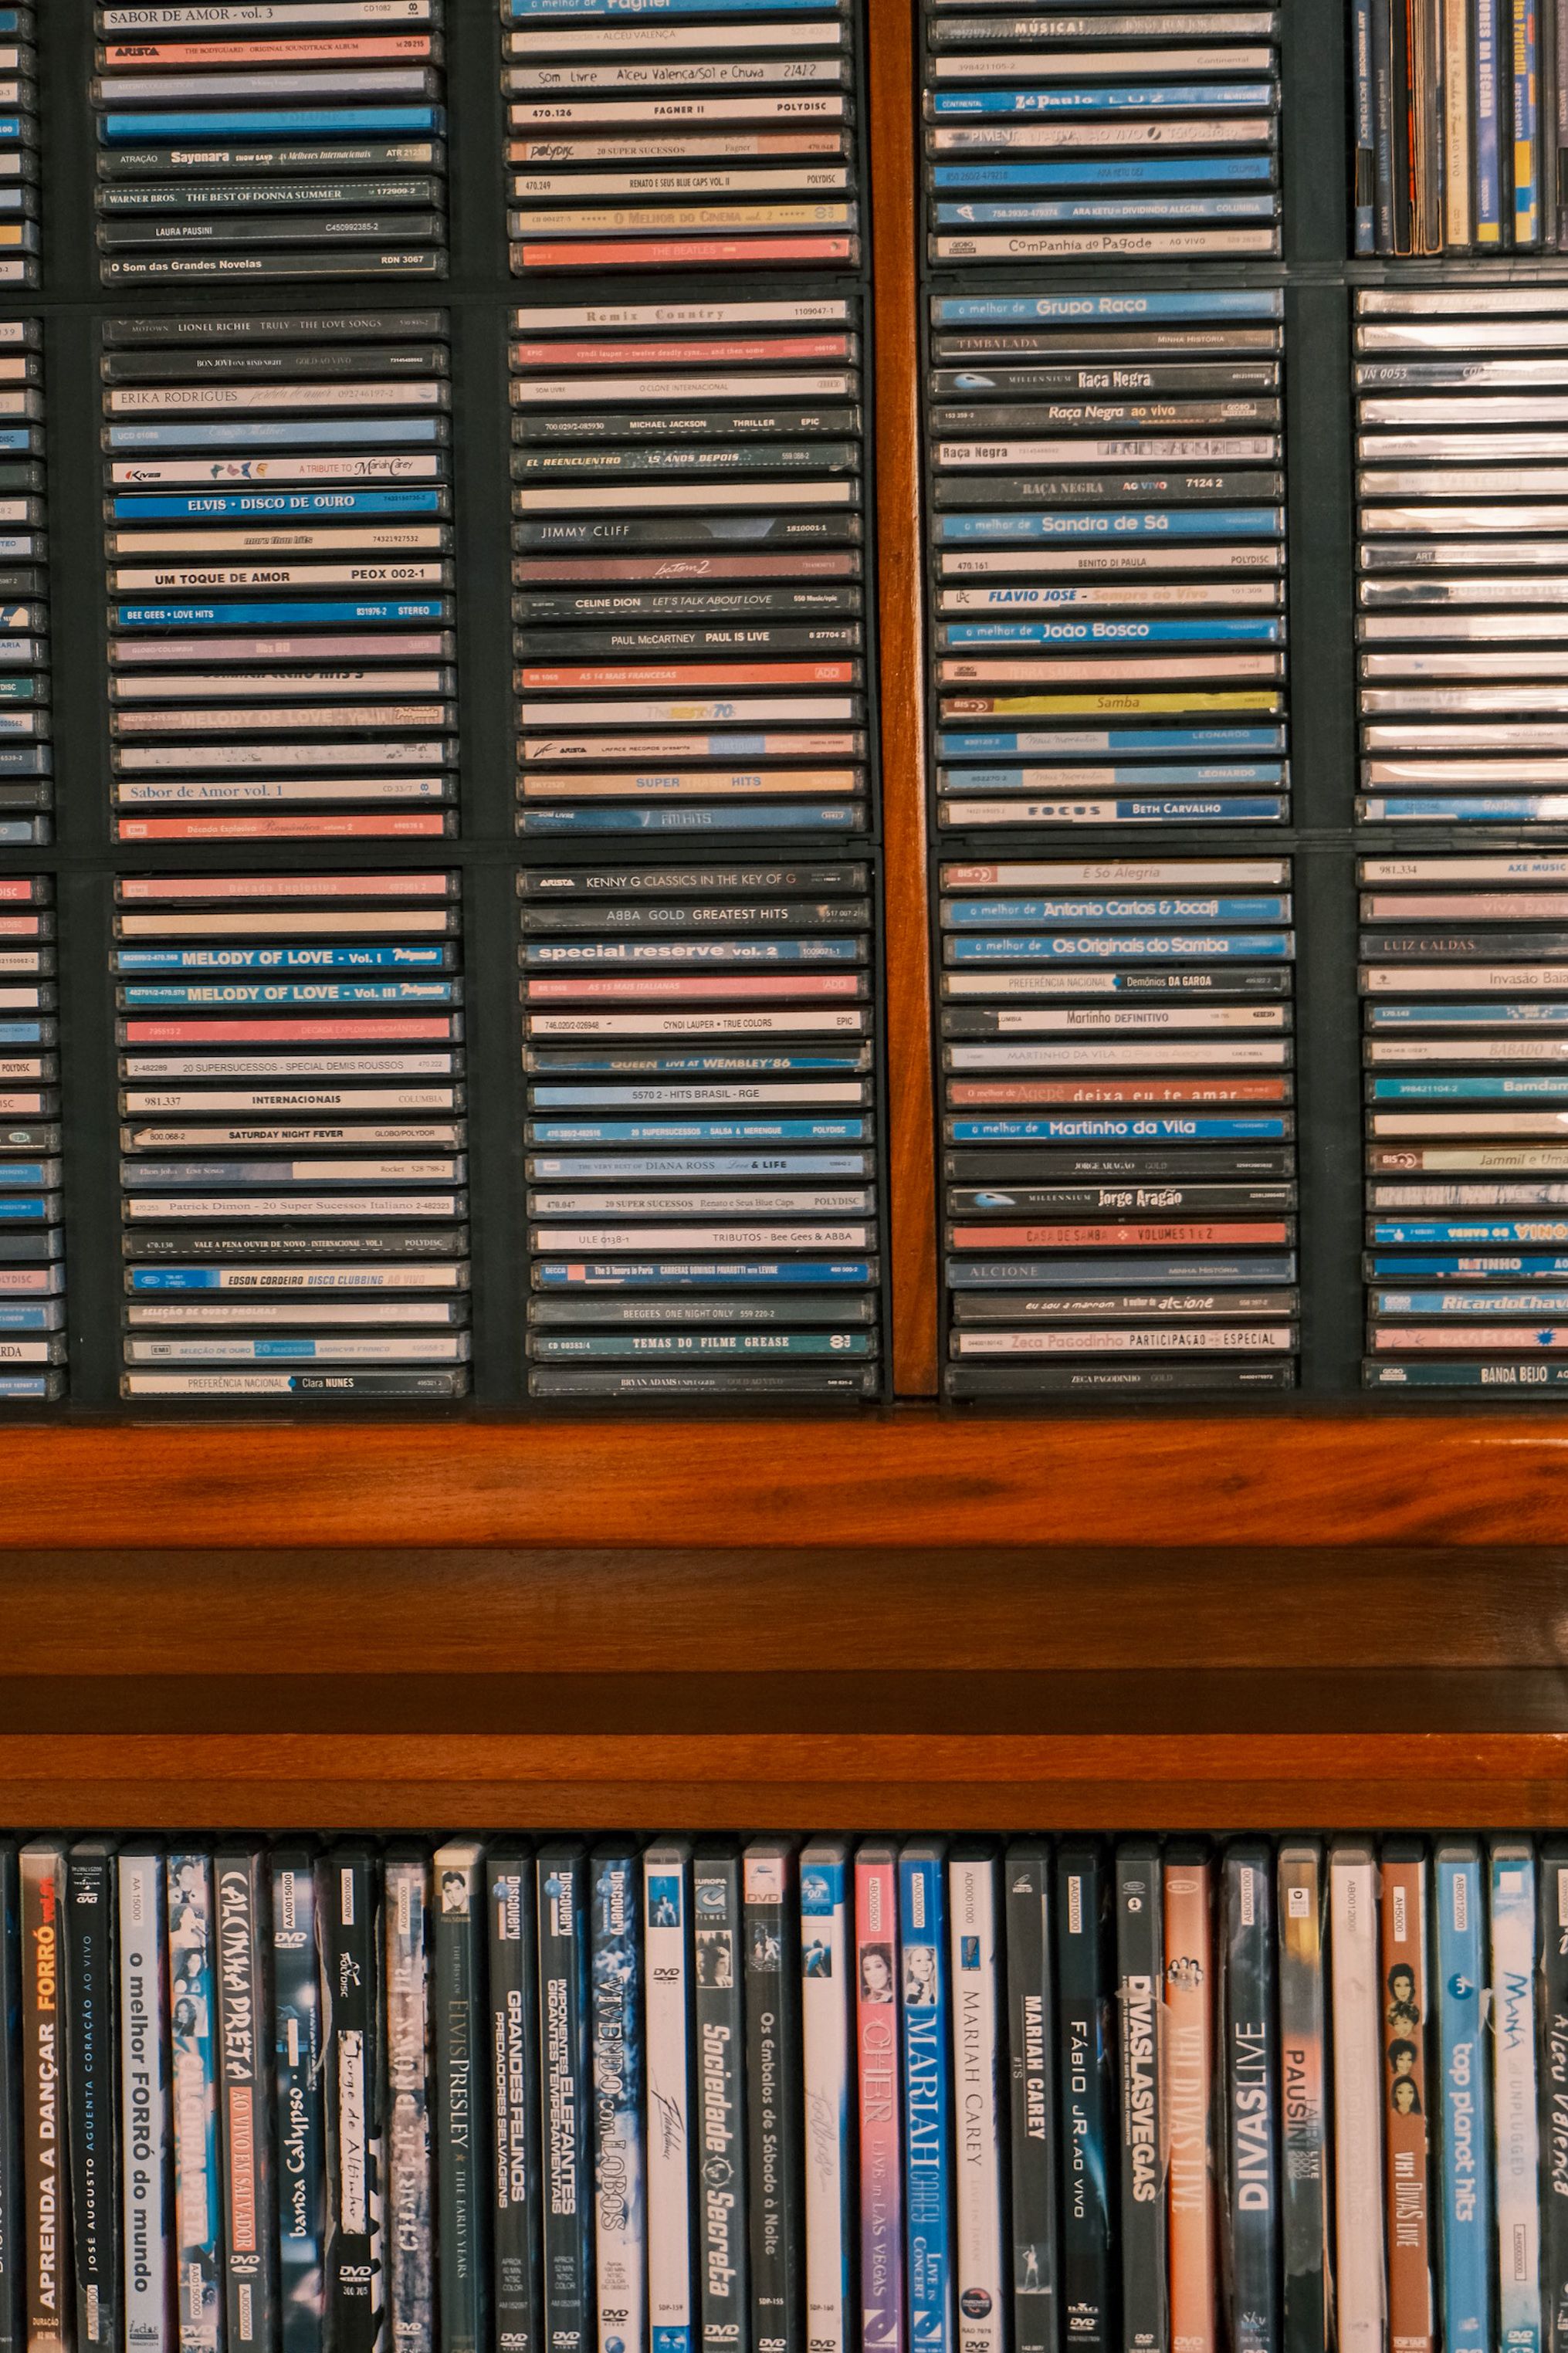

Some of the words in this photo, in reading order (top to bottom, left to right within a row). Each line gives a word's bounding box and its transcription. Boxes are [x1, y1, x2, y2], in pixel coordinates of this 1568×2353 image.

[110, 10, 159, 24] SABOR
[162, 10, 181, 22] DE
[185, 8, 229, 21] AMOR
[241, 8, 263, 19] vol.
[266, 8, 273, 19] 3
[1015, 20, 1083, 33] MÚSICA!
[115, 48, 159, 56] ARISTA
[120, 154, 157, 164] ATRAÇÃO
[171, 151, 229, 164] Sayonara
[186, 193, 207, 201] THE
[210, 192, 235, 201] BEST
[238, 191, 250, 200] OF
[252, 191, 293, 200] DONNA
[296, 189, 341, 199] SUMMER
[156, 227, 180, 235] LAURA
[182, 226, 212, 235] PAUSINI
[111, 262, 119, 272] O
[123, 262, 146, 271] Som
[149, 262, 168, 270] das
[171, 260, 216, 269] Grandes
[219, 259, 262, 268] Novelas
[587, 312, 637, 321] Remix
[655, 309, 725, 320] Country
[1037, 299, 1093, 316] Grupo
[1099, 298, 1146, 313] Raça
[1079, 372, 1109, 388] Raça
[1113, 371, 1150, 387] Negra
[121, 393, 159, 404] ERIKA
[164, 391, 238, 402] RODRIGUES
[527, 458, 539, 466] EL
[544, 456, 621, 466] REENCUENTRO
[188, 499, 226, 511] ELVIS
[241, 499, 286, 510] DISCO
[290, 498, 309, 508] DE
[314, 496, 354, 507] OURO
[541, 526, 587, 538] JIMMY
[594, 525, 629, 536] CLIFF
[1042, 516, 1109, 532] Sandra
[1114, 516, 1138, 530] de
[1144, 515, 1168, 530] Sá
[575, 599, 611, 608] CELINE
[614, 598, 641, 607] DION
[1043, 588, 1076, 601] JOSÉ
[611, 635, 635, 645] PAUL
[638, 635, 695, 645] McCARTNEY
[706, 633, 732, 642] PAUL
[735, 633, 744, 642] IS
[747, 631, 769, 641] LIVE
[1043, 624, 1086, 638] João
[1092, 623, 1149, 637] Bosco
[1097, 696, 1140, 708] Samba
[587, 878, 627, 888] KENNY
[631, 877, 641, 886] G
[539, 946, 625, 960] special
[634, 945, 723, 956] reserve
[733, 947, 760, 956] vol.
[767, 946, 777, 956] 2
[1052, 941, 1074, 953] Os
[1077, 940, 1143, 956] Originais
[1146, 940, 1169, 953] do
[1171, 939, 1228, 952] Samba
[1384, 941, 1415, 950] LUIZ
[1421, 940, 1475, 950] CALDAS
[187, 988, 259, 1000] MELODY
[265, 987, 288, 999] OF
[293, 987, 339, 999] LOVE
[354, 988, 378, 998] Vol.
[383, 987, 396, 997] III
[2, 1064, 30, 1072] POLYDISC
[252, 1095, 340, 1104] INTERNACIONAIS
[1050, 1121, 1126, 1135] Martinho
[1133, 1121, 1157, 1134] da
[1162, 1120, 1195, 1134] Vila
[1099, 1189, 1132, 1207] Jorge
[1136, 1188, 1182, 1206] Aragão
[634, 1338, 671, 1348] TEMAS
[679, 1338, 692, 1348] DO
[701, 1337, 736, 1347] FILME
[744, 1337, 789, 1347] GREASE
[1224, 1332, 1275, 1345] ESPECIAL
[302, 1378, 323, 1387] Clara
[326, 1377, 354, 1387] NUNES
[1482, 1368, 1516, 1382] BANDA
[1520, 1366, 1547, 1381] BEIJO
[507, 1877, 520, 1939] Discovery
[1071, 1878, 1079, 1931] AA0010000
[1457, 1877, 1465, 1928] AB0012000
[221, 1871, 250, 1996] CALCINHA
[32, 1926, 56, 2011] FORRÓ
[130, 1953, 143, 1966] o
[130, 1976, 147, 2063] melhor
[449, 2000, 467, 2057] ELVIS
[760, 2013, 774, 2033] Os
[226, 1998, 253, 2079] PRETA
[963, 1991, 980, 2081] MARIAH
[1025, 1996, 1045, 2069] MARIAH
[508, 1991, 524, 2107] GRANDES
[1071, 2021, 1088, 2092] FÁBIO
[1236, 2022, 1265, 2087] LIVE
[760, 2039, 775, 2104] Embalos
[1449, 2043, 1472, 2084] top
[39, 2023, 58, 2138] DANÇAR
[703, 2023, 733, 2152] Sociedade
[132, 2072, 154, 2160] FORRÓ
[450, 2060, 469, 2148] PRESLEY
[1026, 2077, 1045, 2139] CAREY
[599, 2099, 615, 2135] COM
[763, 2111, 776, 2128] de
[1072, 2105, 1087, 2135] JR
[284, 2087, 309, 2173] Calypso
[965, 2094, 983, 2165] CAREY
[1449, 2091, 1475, 2173] planet
[510, 2108, 525, 2202] FELINOS
[560, 2077, 576, 2214] ELEFANTES
[1236, 2088, 1268, 2210] DIVAS
[39, 2148, 56, 2168] A
[763, 2135, 777, 2193] Sábado
[1073, 2148, 1083, 2170] AO
[1395, 2152, 1414, 2178] VH1
[86, 2158, 97, 2229] AUGUSTO
[134, 2169, 151, 2199] do
[600, 2139, 627, 2229] LOBOS
[290, 2179, 306, 2238] banda
[764, 2196, 777, 2208] à
[1073, 2179, 1084, 2218] VIVO
[1396, 2182, 1423, 2219] DIVAS
[1455, 2179, 1475, 2222] hits
[39, 2179, 56, 2309] APRENDA
[707, 2191, 736, 2296] Secreta
[765, 2215, 778, 2255] Noite
[1396, 2224, 1419, 2247] LIVE
[87, 2238, 97, 2271] JOSÉ
[134, 2209, 151, 2292] mundo
[231, 2256, 259, 2264] DVD
